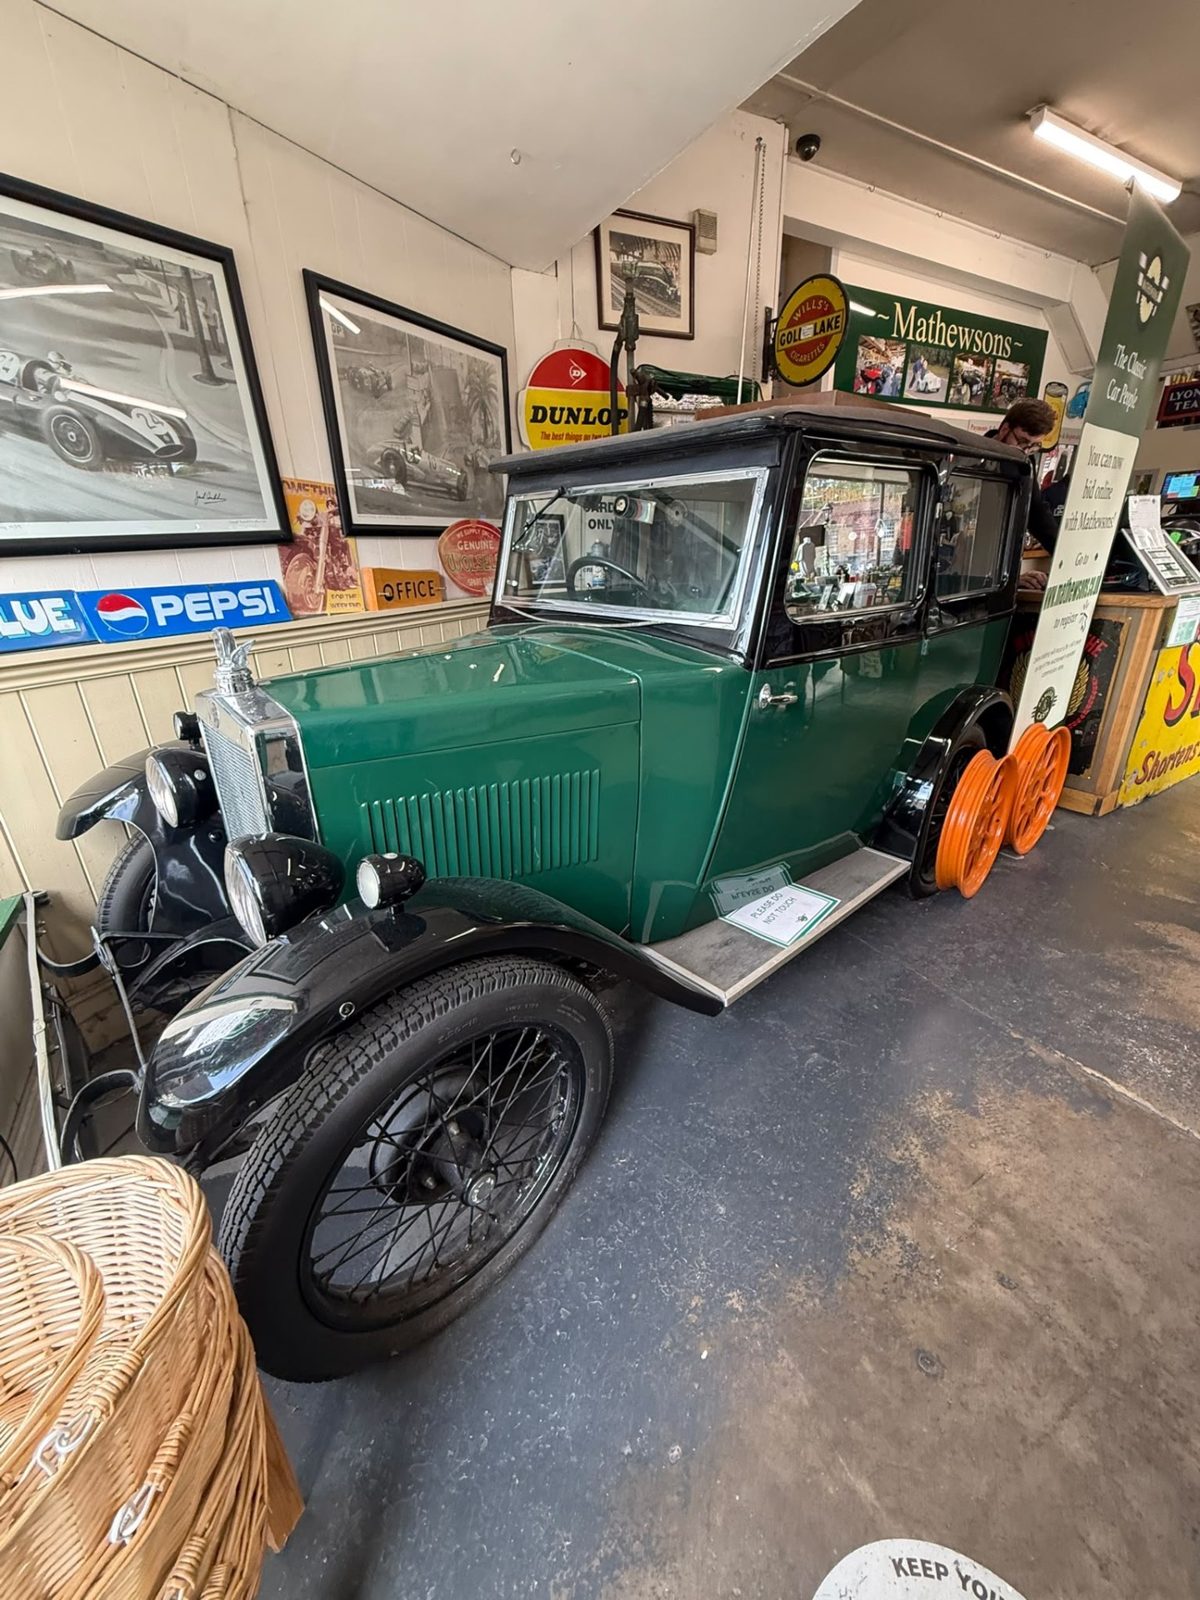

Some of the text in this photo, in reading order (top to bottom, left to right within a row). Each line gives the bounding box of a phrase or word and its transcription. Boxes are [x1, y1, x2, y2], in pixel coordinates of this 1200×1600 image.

[793, 299, 830, 320] WILLS'S
[813, 315, 841, 336] LAKE
[891, 301, 1012, 359] Mathewsons
[1114, 344, 1148, 380] The Classic
[1106, 378, 1138, 413] Car People
[1174, 401, 1198, 411] TEA
[530, 405, 629, 426] DUNLOP
[541, 431, 550, 440] The
[551, 432, 565, 440] best
[566, 431, 583, 443] things
[1087, 445, 1101, 467] You
[1100, 452, 1112, 468] can
[1082, 478, 1113, 499] bid online
[1065, 511, 1079, 531] with
[457, 540, 495, 550] GENUINE
[1074, 552, 1090, 566] Go to
[383, 580, 436, 601] OFFICE
[151, 587, 276, 626] PEPSI
[1135, 741, 1199, 785] Shortens
[750, 892, 784, 919] PLEASE DO
[763, 896, 797, 924] NOT TOUCH
[892, 1557, 949, 1581] KEEP
